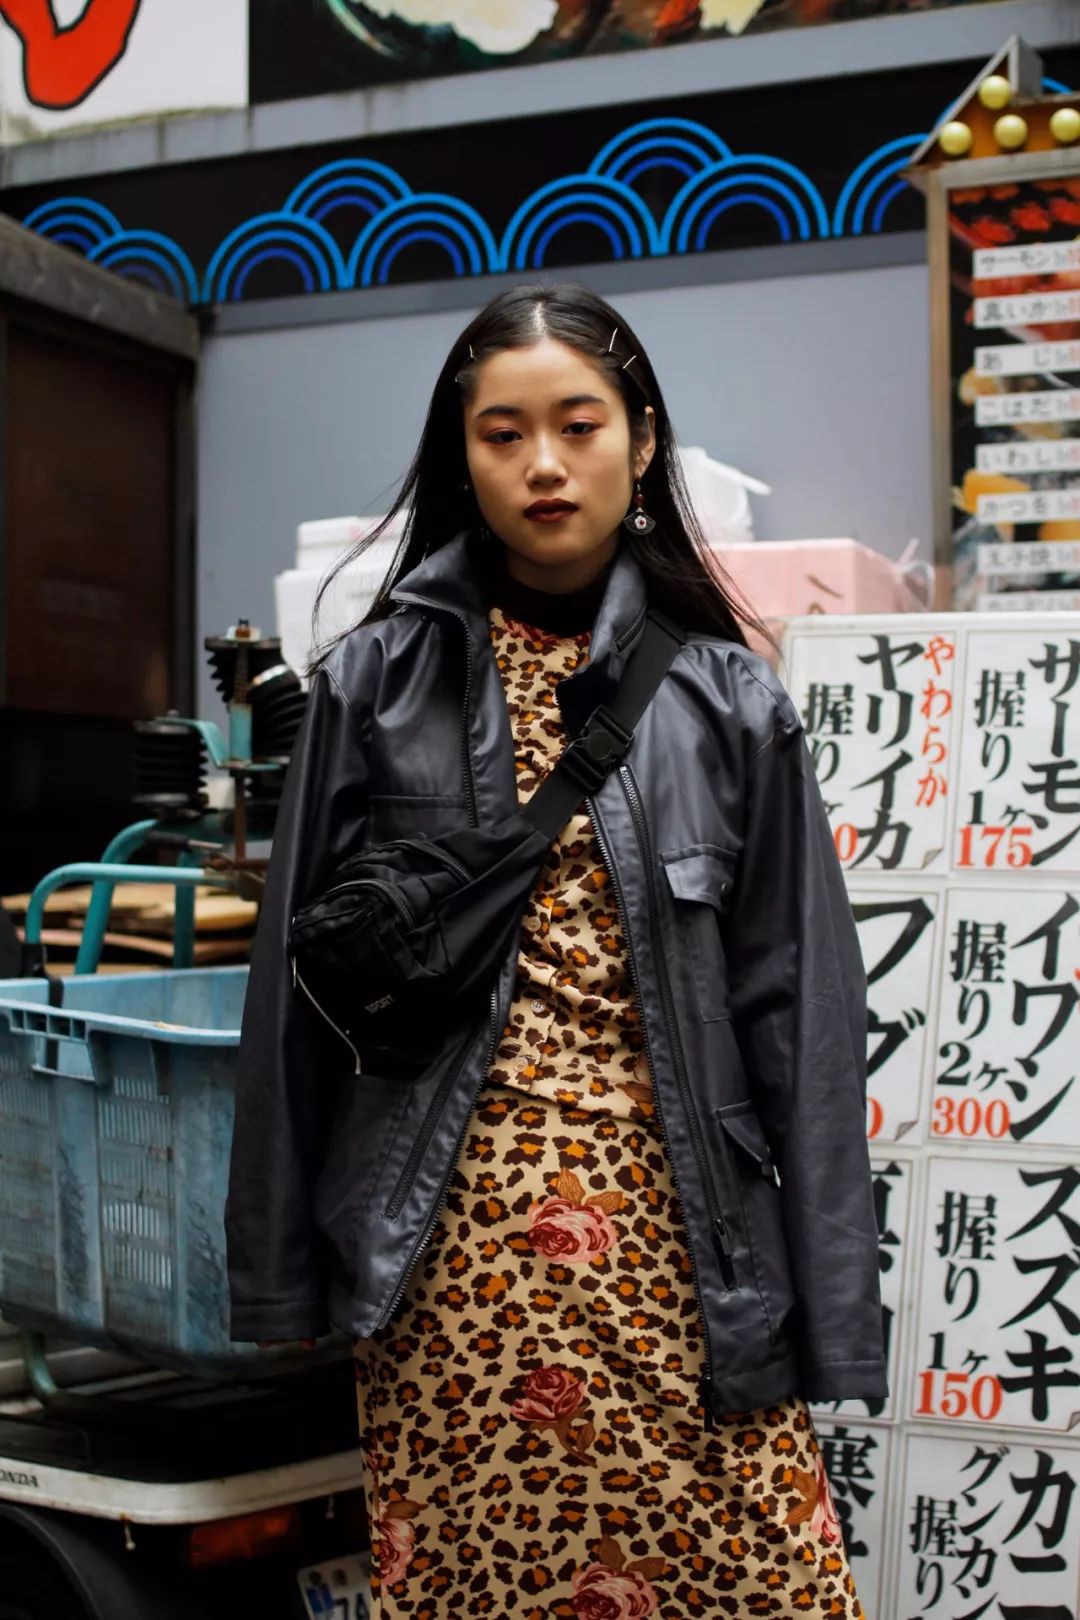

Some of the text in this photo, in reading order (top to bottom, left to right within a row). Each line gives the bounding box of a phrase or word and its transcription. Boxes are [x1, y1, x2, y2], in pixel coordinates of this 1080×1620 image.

[849, 634, 925, 870] ヤリイカ
[915, 635, 954, 808] やわらか
[956, 825, 1033, 868] 175
[1004, 892, 1080, 1141] イワシ
[931, 1096, 1010, 1138] 300
[914, 1370, 1003, 1421] 150
